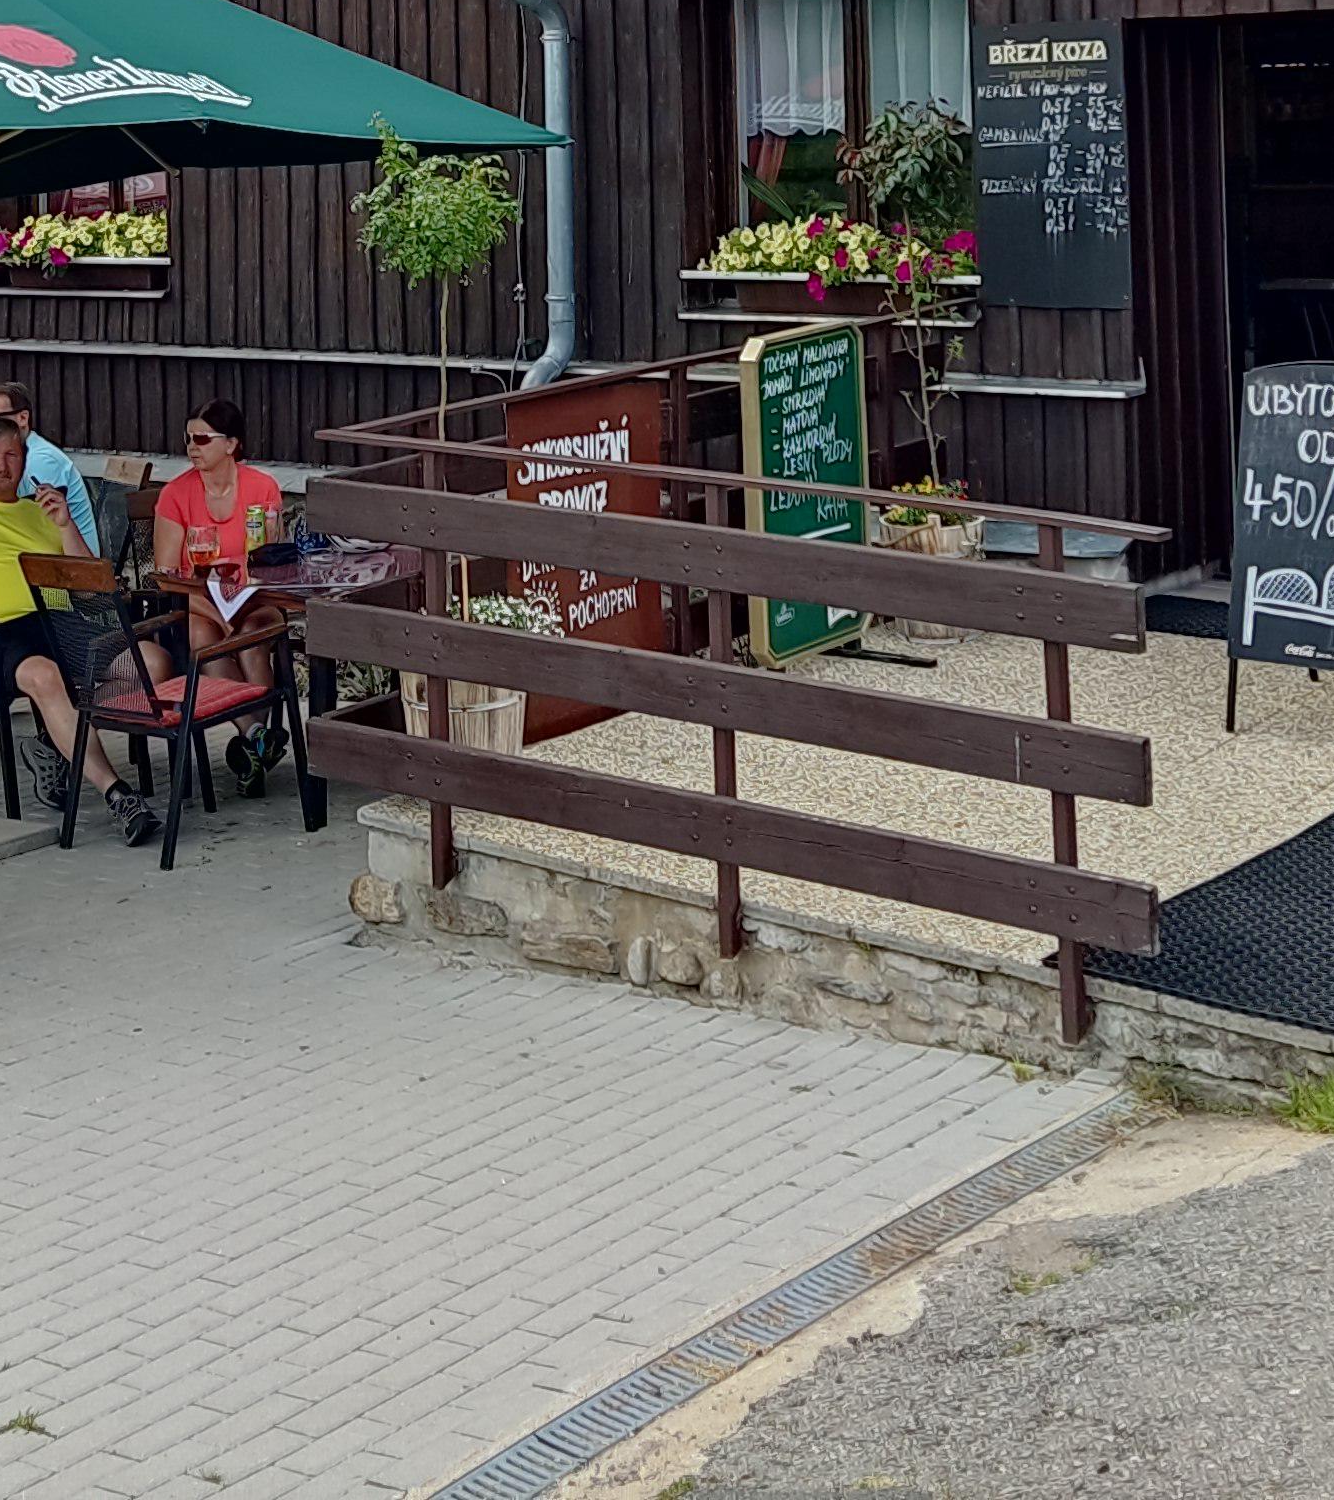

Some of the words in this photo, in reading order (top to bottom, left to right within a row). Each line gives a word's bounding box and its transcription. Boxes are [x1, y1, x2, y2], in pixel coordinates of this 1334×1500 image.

[988, 38, 1049, 65] BŘEZÍ
[1052, 40, 1108, 63] KOZA
[92, 55, 243, 102] Urquell
[568, 576, 639, 632] POCHOPENÍ
